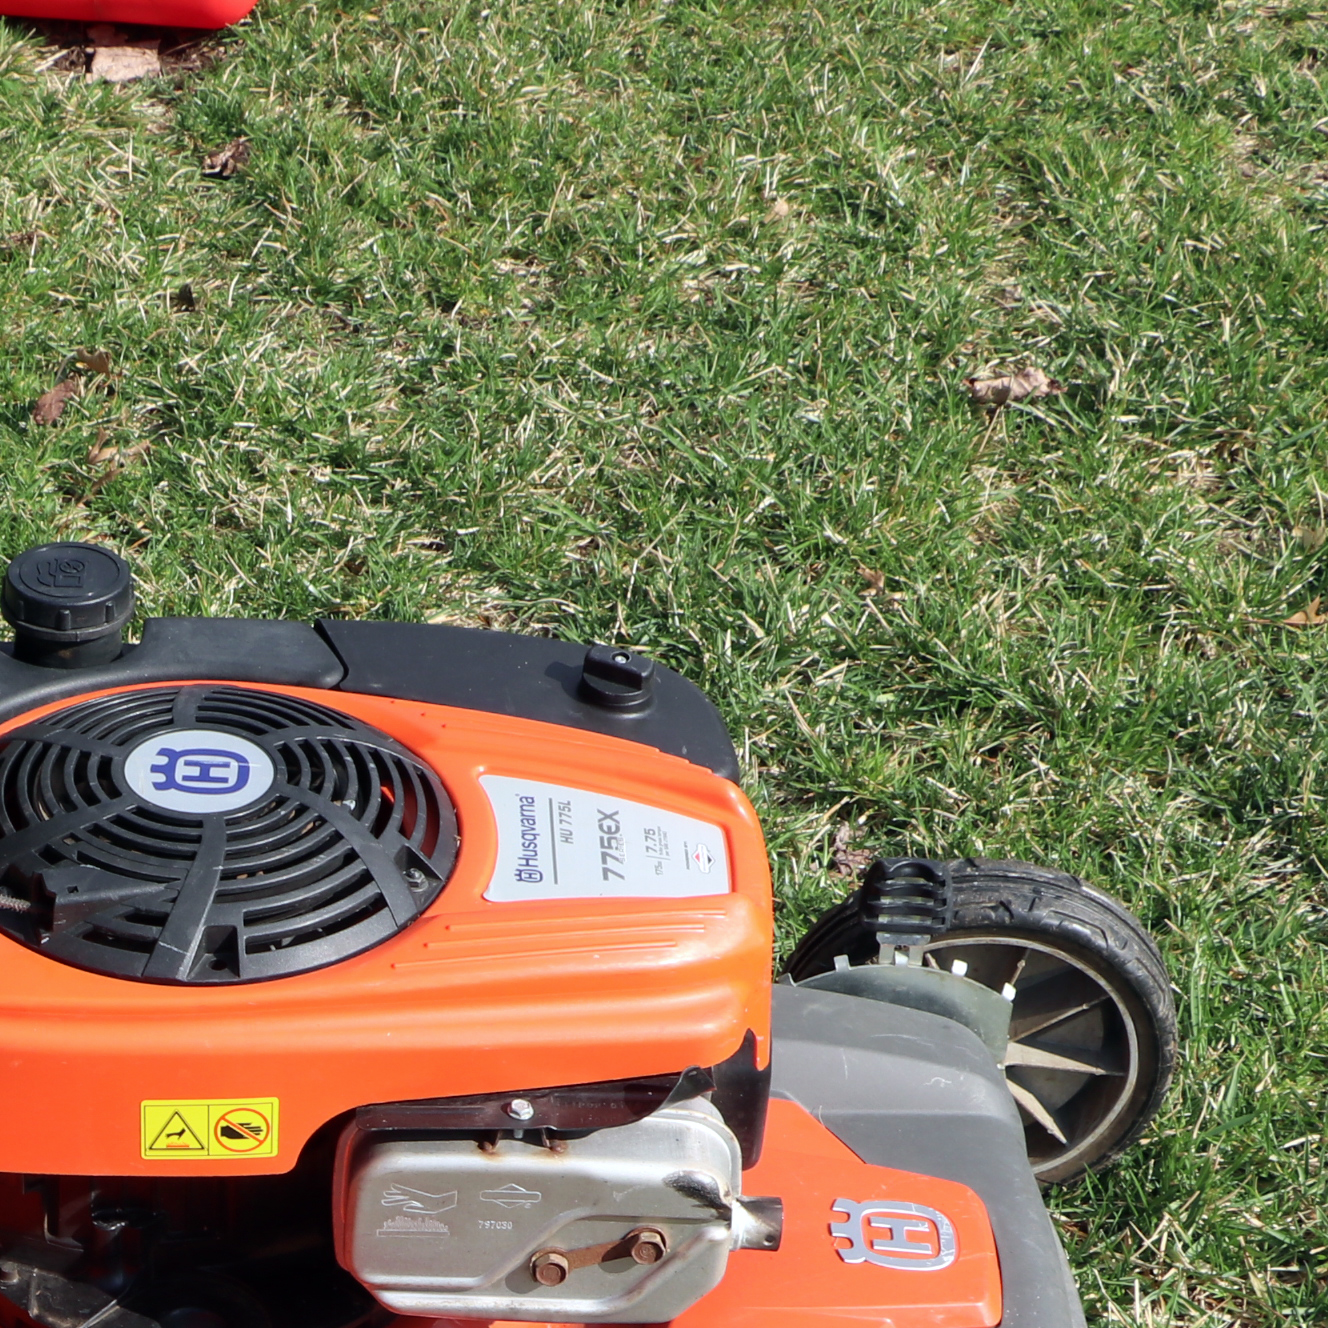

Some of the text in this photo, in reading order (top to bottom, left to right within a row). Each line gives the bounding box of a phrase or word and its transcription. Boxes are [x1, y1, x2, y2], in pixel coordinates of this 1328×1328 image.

[519, 796, 540, 867] Husqvarna
[558, 800, 574, 844] HU 775L
[644, 828, 657, 853] 7.75
